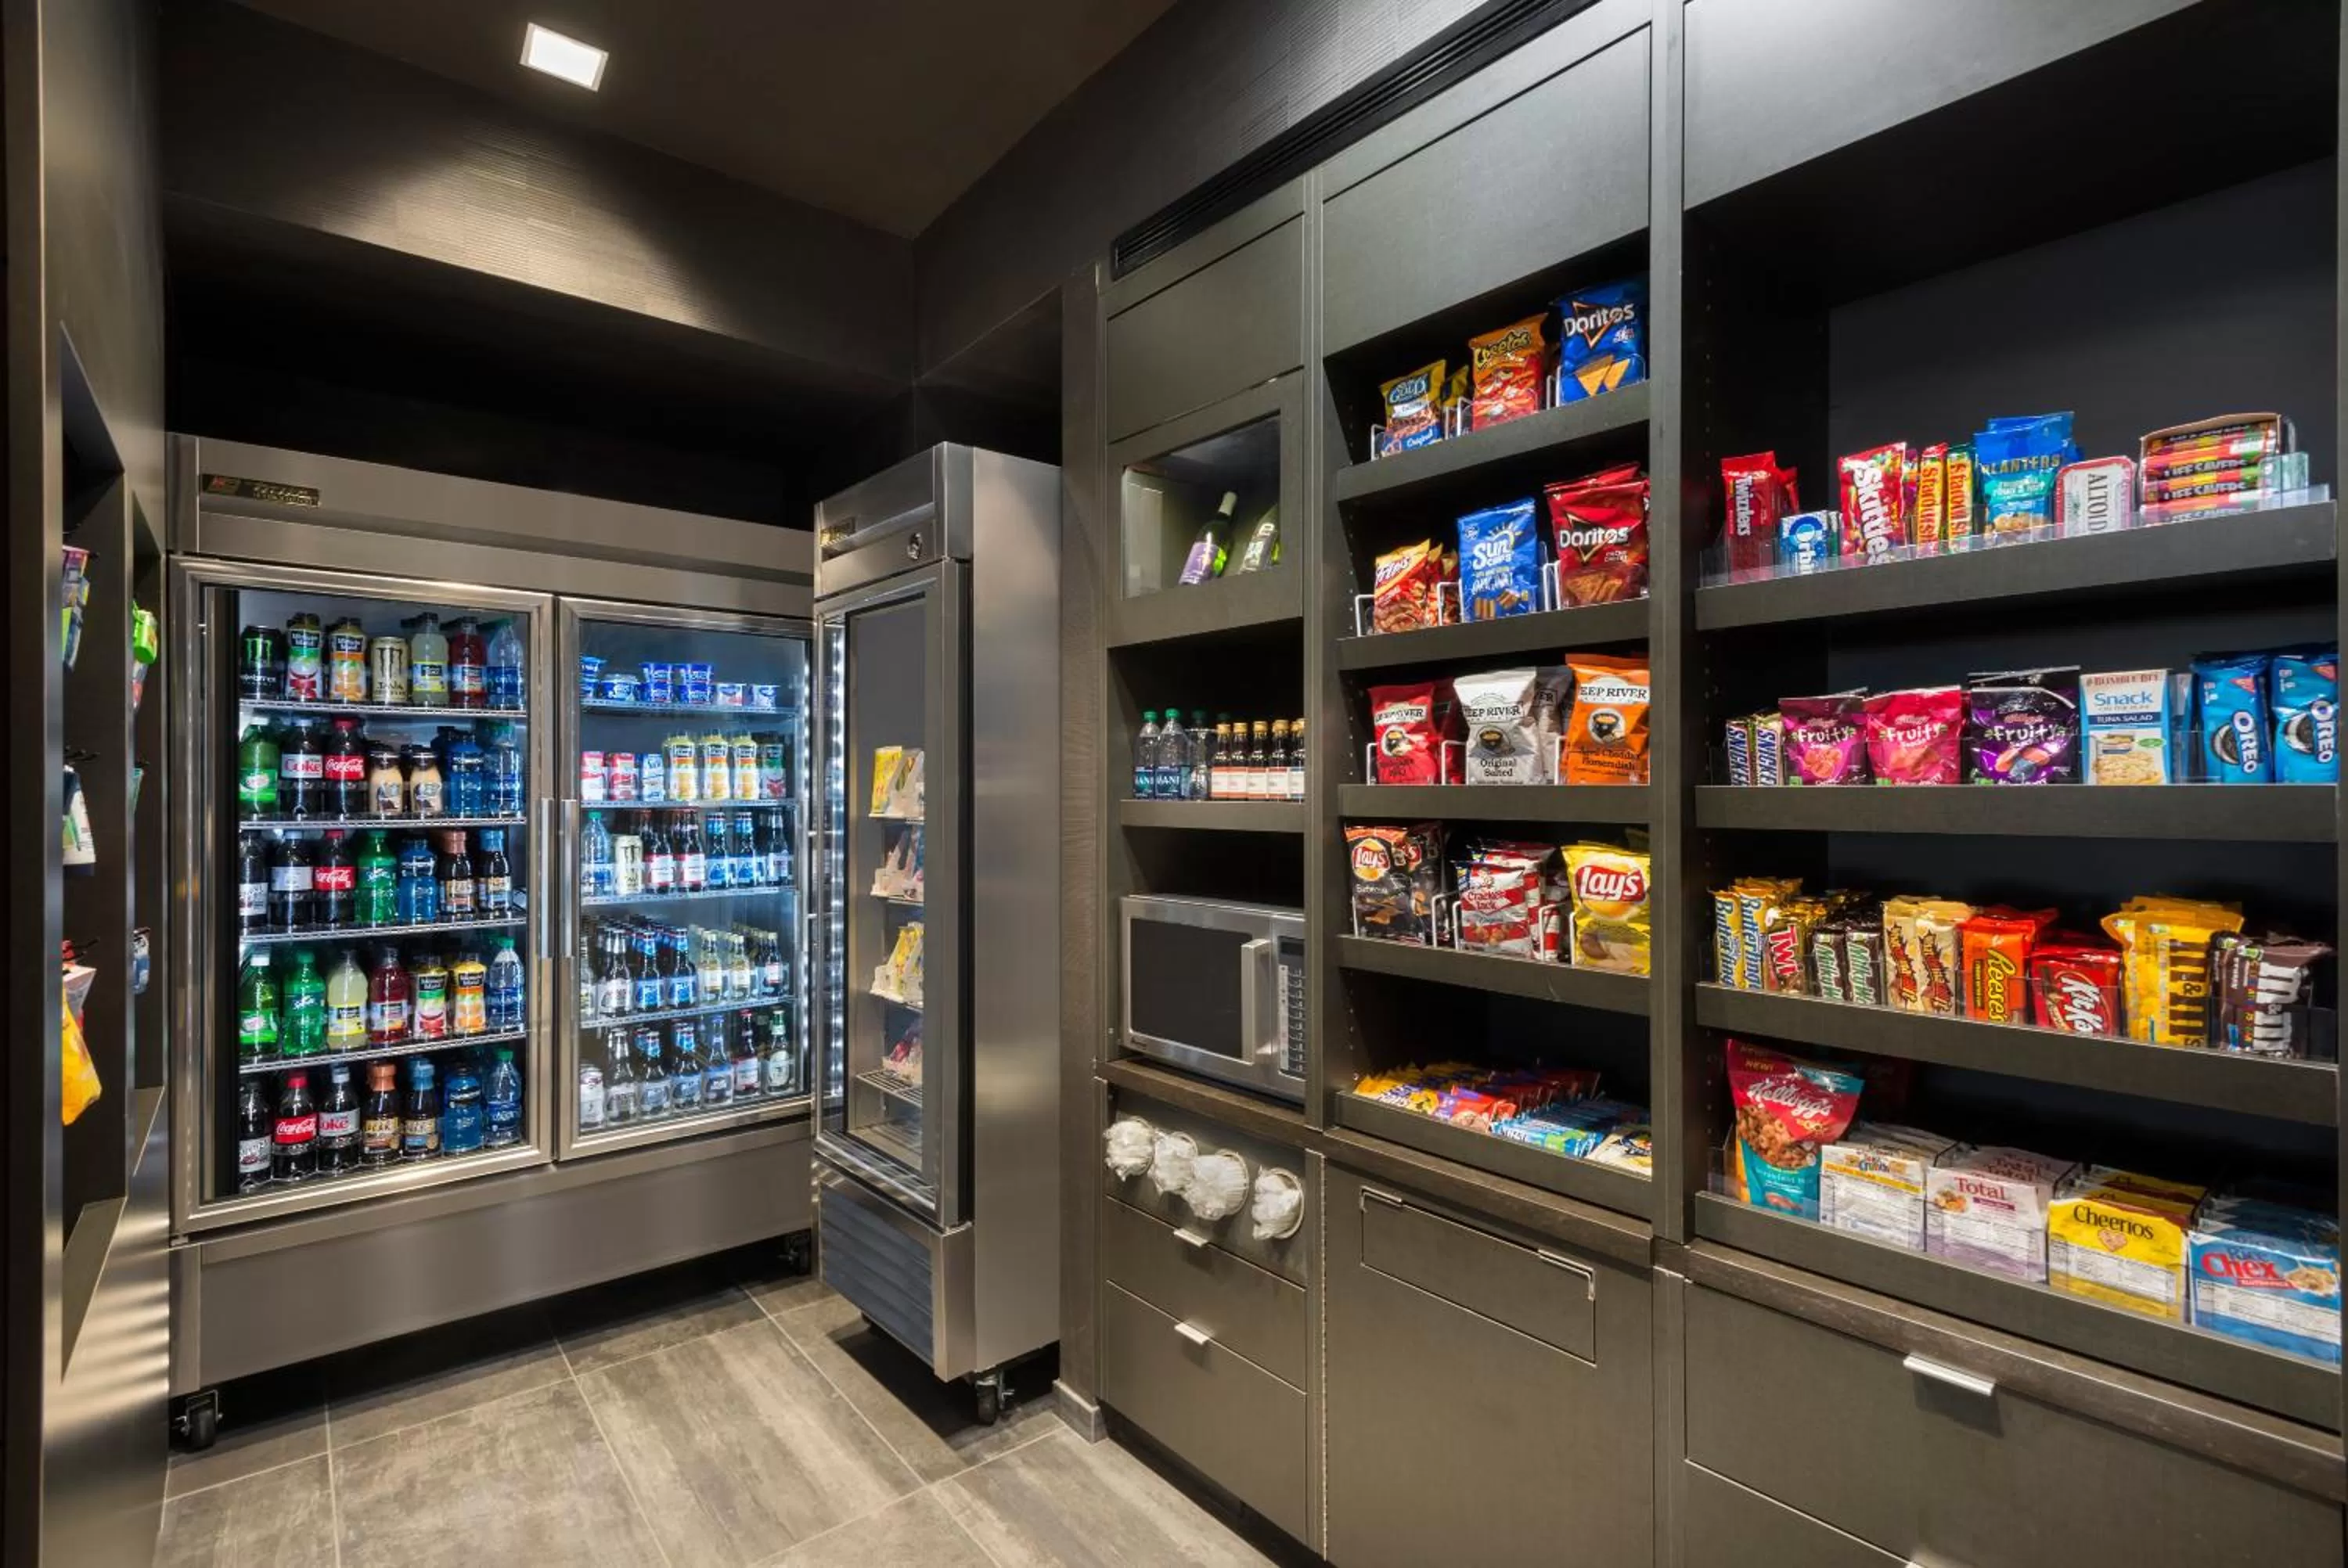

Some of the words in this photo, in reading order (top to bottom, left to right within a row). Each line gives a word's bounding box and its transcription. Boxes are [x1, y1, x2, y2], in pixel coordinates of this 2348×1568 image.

[1564, 303, 1634, 337] Doritos
[1853, 464, 1893, 565] Skittles
[2087, 473, 2107, 531] ALTOID
[1472, 539, 1511, 570] Sun
[1560, 527, 1629, 548] Doritos
[1580, 686, 1604, 697] EEP
[1607, 687, 1647, 699] RIVER
[2094, 690, 2155, 707] Snack
[1486, 706, 1522, 717] RIVER
[1798, 725, 1850, 743] Fruity
[1887, 722, 1941, 743] Fruity
[2233, 710, 2257, 773] OREO
[2311, 700, 2335, 763] OREO
[1480, 758, 1518, 770] Original
[1484, 767, 1513, 778] Salted
[1728, 726, 1749, 786] SNICKE
[1580, 866, 1640, 901] Lay's
[1715, 899, 1734, 986] Butterfing
[1740, 897, 1761, 988] Butterfing
[1769, 925, 1798, 976] TWI
[1988, 949, 2015, 1023] Reese's
[2063, 1005, 2104, 1033] Ka
[1747, 1078, 1832, 1119] Kellogg's
[1955, 1177, 2005, 1200] Total
[2073, 1204, 2154, 1240] Cheerios
[2201, 1252, 2278, 1278] Chex
